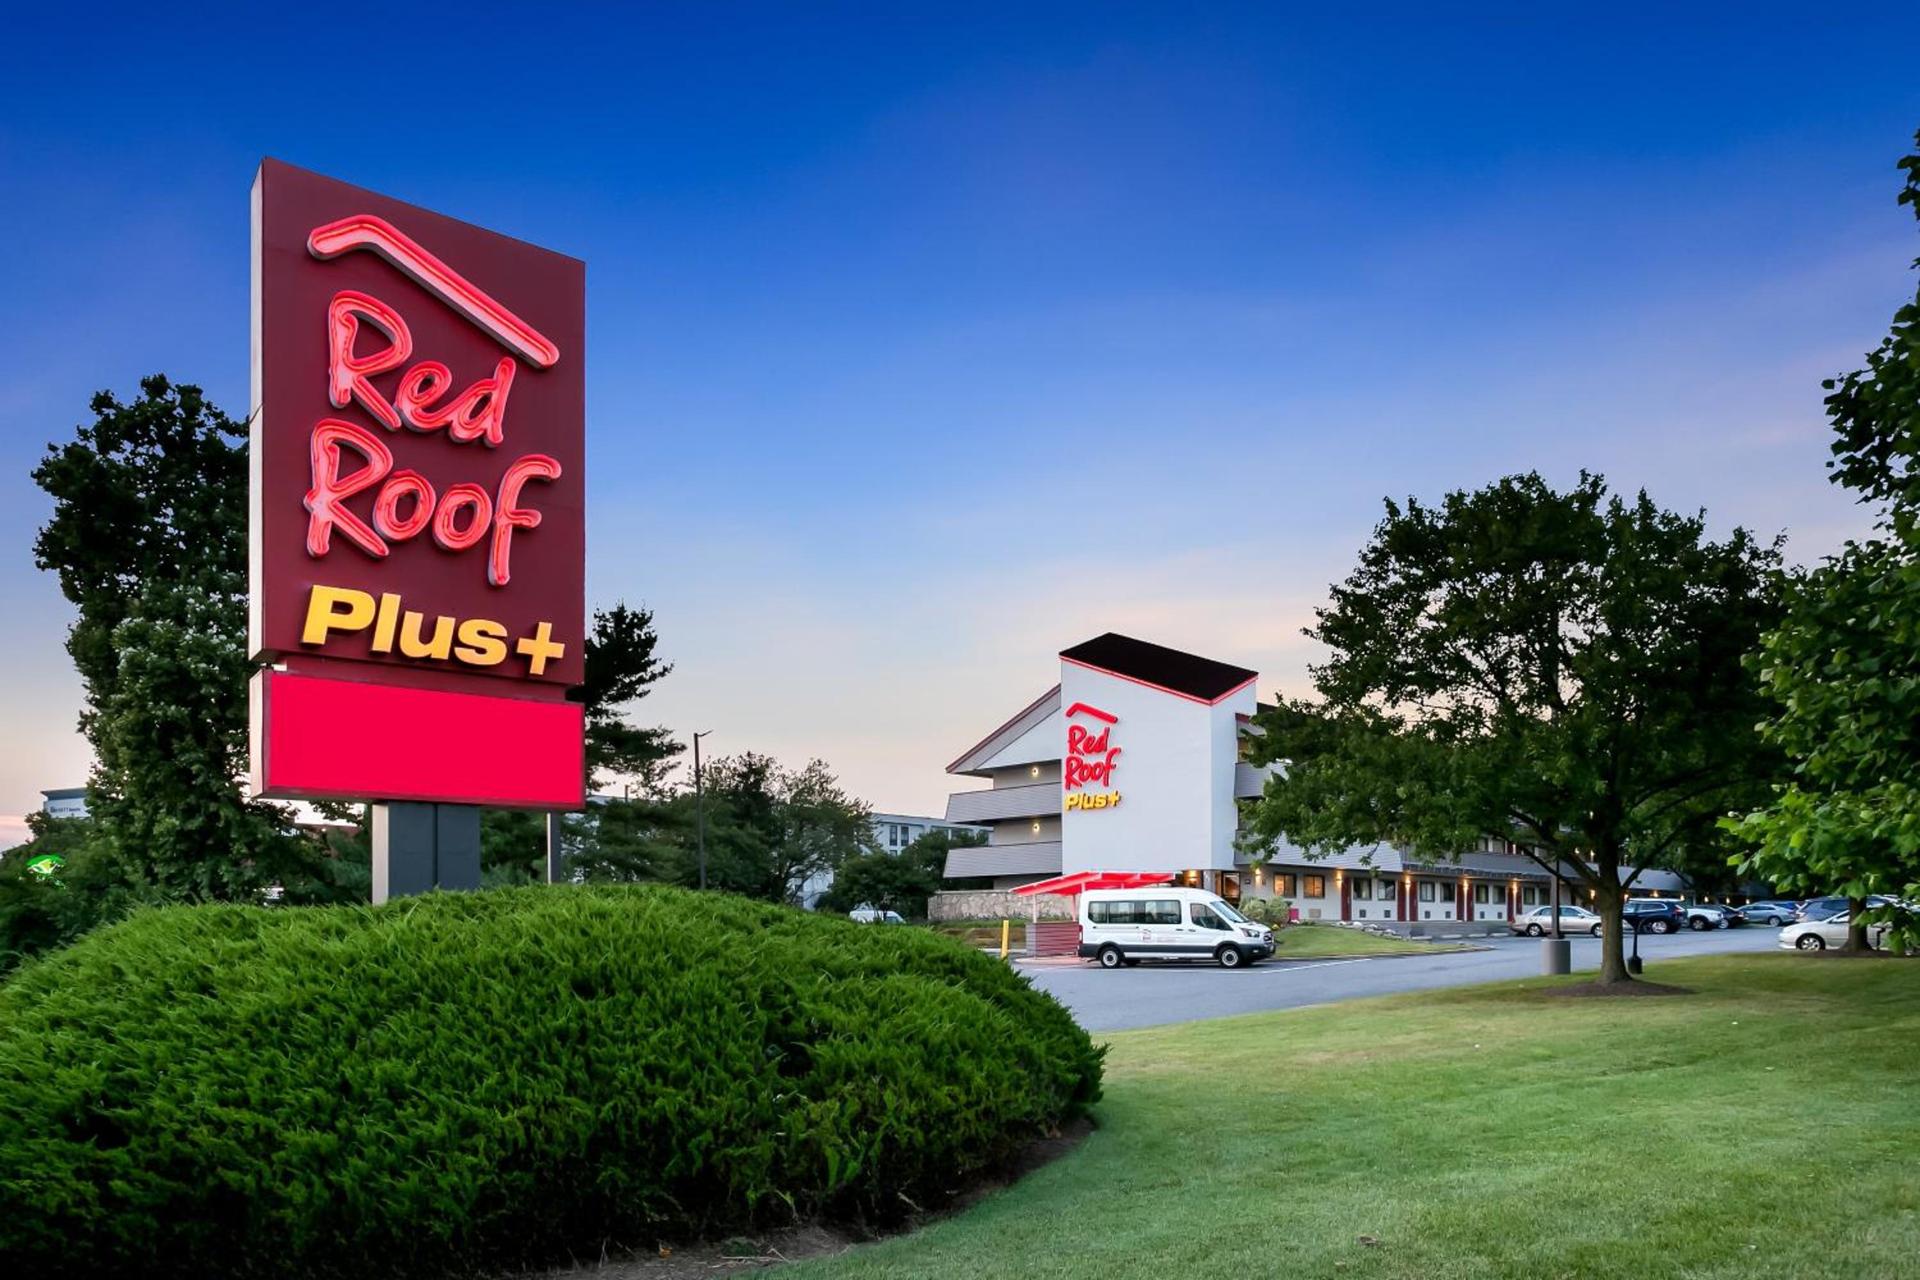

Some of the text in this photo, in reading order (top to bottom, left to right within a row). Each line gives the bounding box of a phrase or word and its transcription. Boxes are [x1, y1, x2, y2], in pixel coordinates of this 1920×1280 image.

[328, 290, 517, 447] Red
[303, 418, 562, 586] Roof
[301, 584, 566, 676] Plus+
[1065, 747, 1121, 790] Roof
[1068, 725, 1110, 755] Red
[1066, 791, 1121, 811] Plus+
